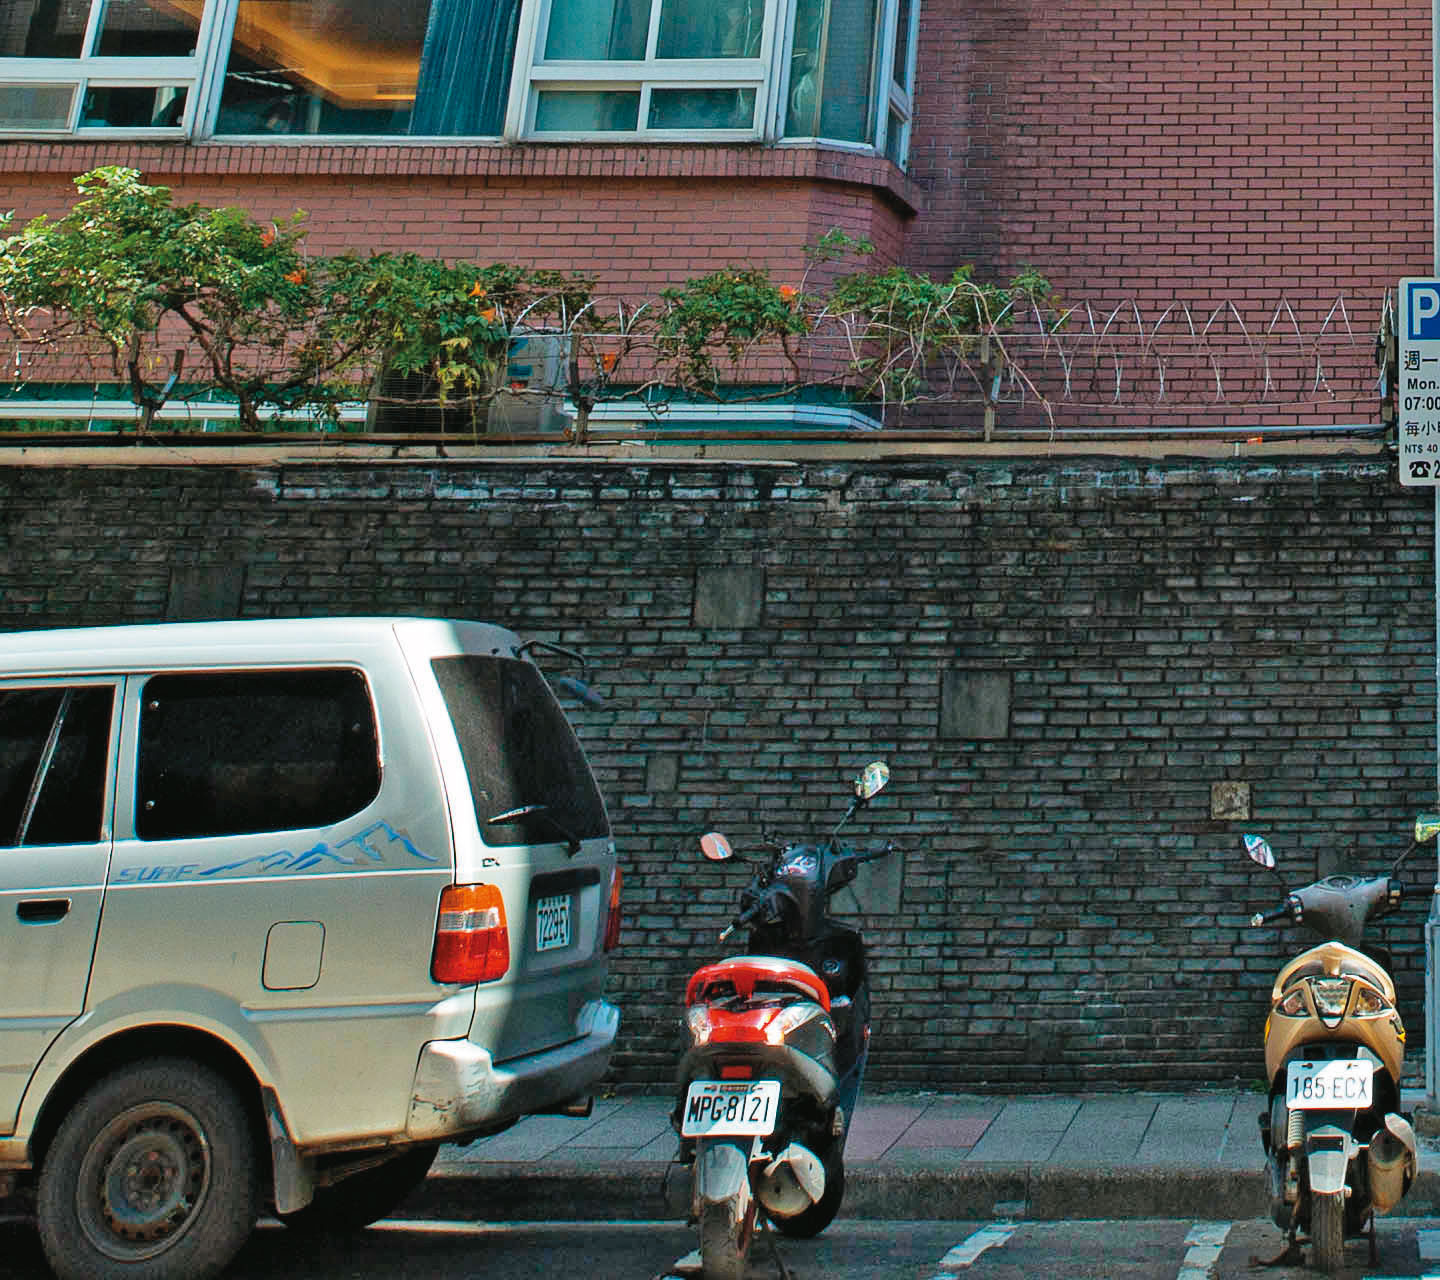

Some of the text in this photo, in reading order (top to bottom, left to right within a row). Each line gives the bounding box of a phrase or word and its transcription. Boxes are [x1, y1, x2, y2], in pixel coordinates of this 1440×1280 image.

[1412, 288, 1440, 336] P
[1407, 378, 1440, 390] Mon.
[1404, 444, 1423, 454] NT$
[1426, 444, 1438, 454] 40
[115, 864, 201, 882] SURF
